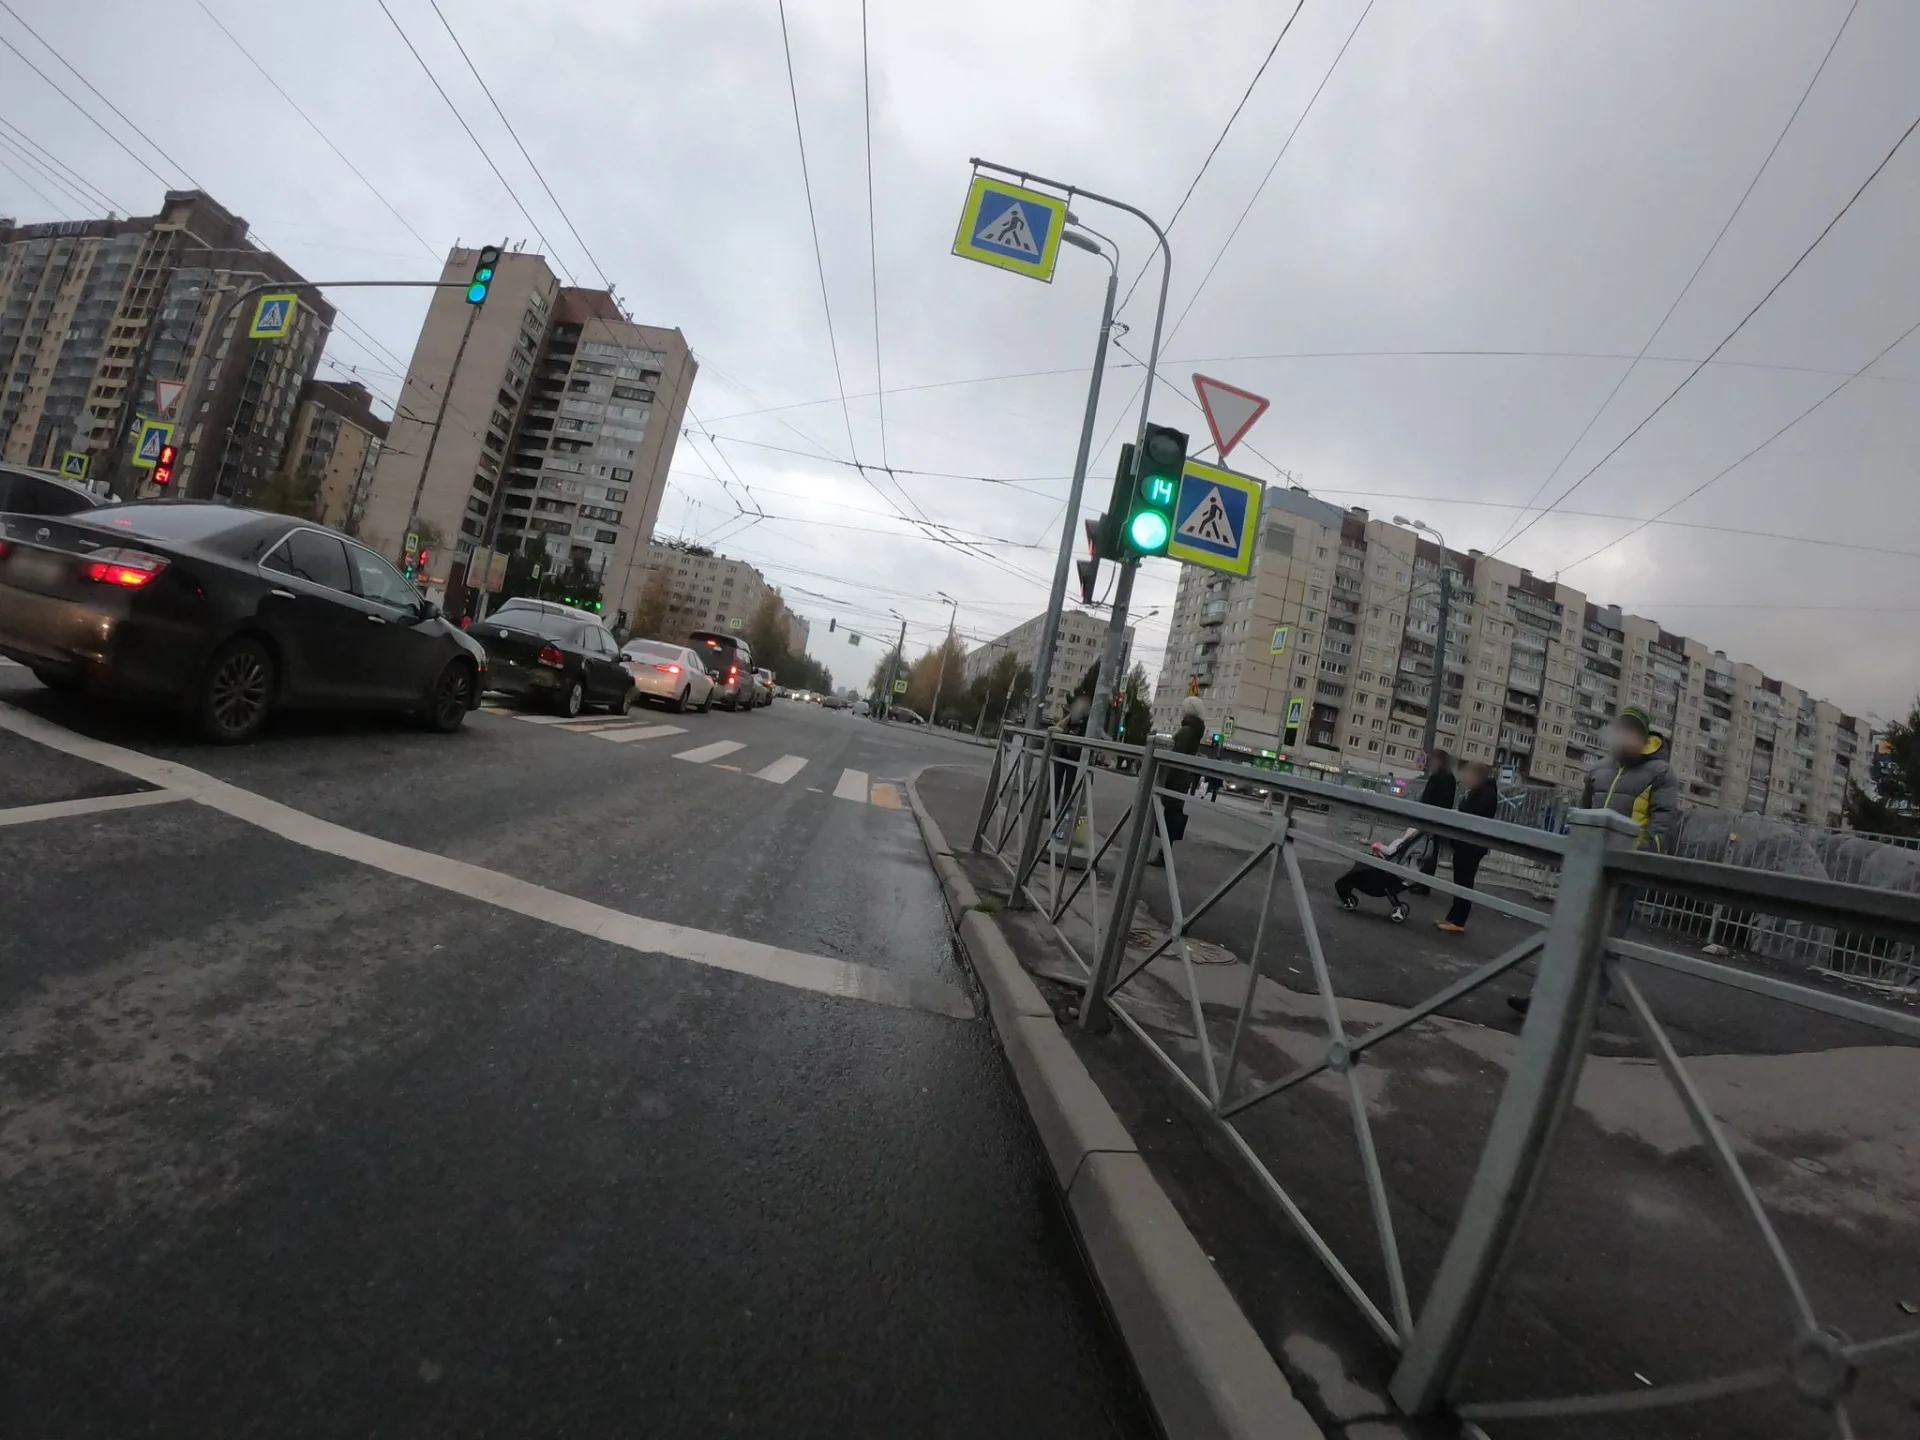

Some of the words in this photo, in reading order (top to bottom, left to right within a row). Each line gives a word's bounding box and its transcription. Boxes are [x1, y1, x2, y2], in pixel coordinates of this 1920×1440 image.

[480, 268, 493, 281] 14
[155, 467, 170, 482] 24
[1152, 478, 1172, 504] 14
